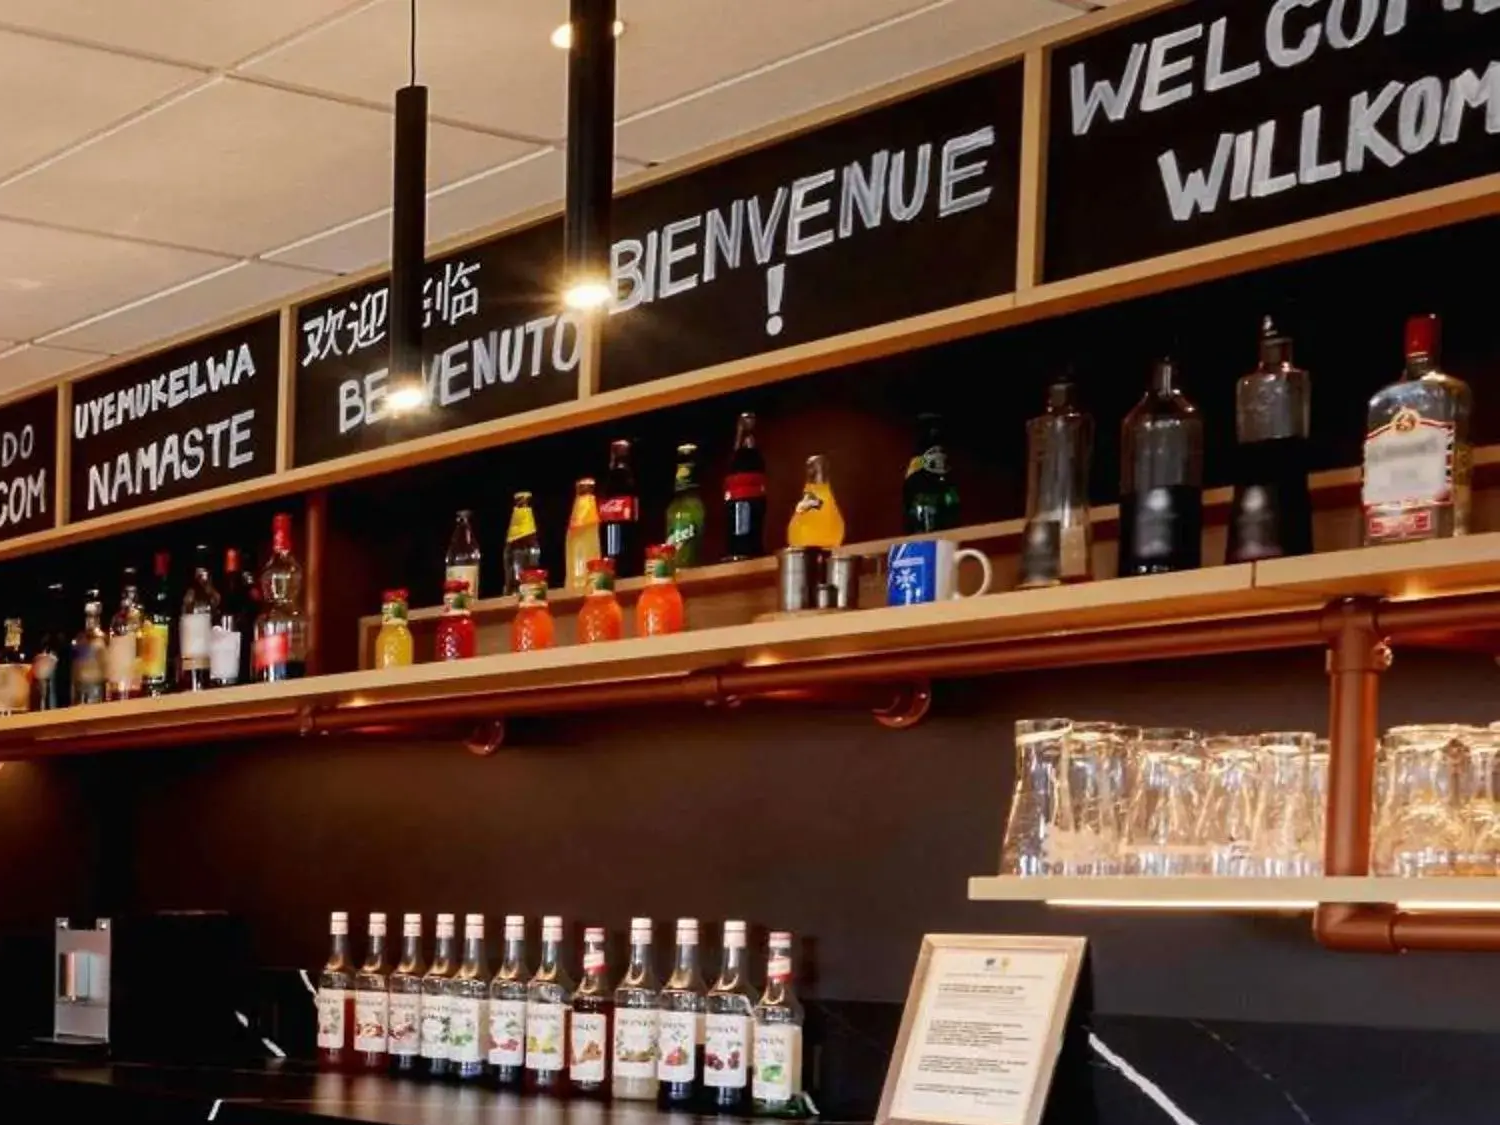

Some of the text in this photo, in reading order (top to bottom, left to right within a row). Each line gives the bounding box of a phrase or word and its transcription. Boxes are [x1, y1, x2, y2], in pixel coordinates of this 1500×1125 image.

[1070, 0, 1500, 136] WELCO
[1157, 61, 1500, 221] WILLKOM
[609, 125, 996, 315] BIENVENUE
[302, 261, 481, 367] 欢迎临
[338, 311, 582, 434] BEVENUTO
[74, 343, 256, 439] UYEMUKELWA
[87, 409, 255, 511] NAMASTE
